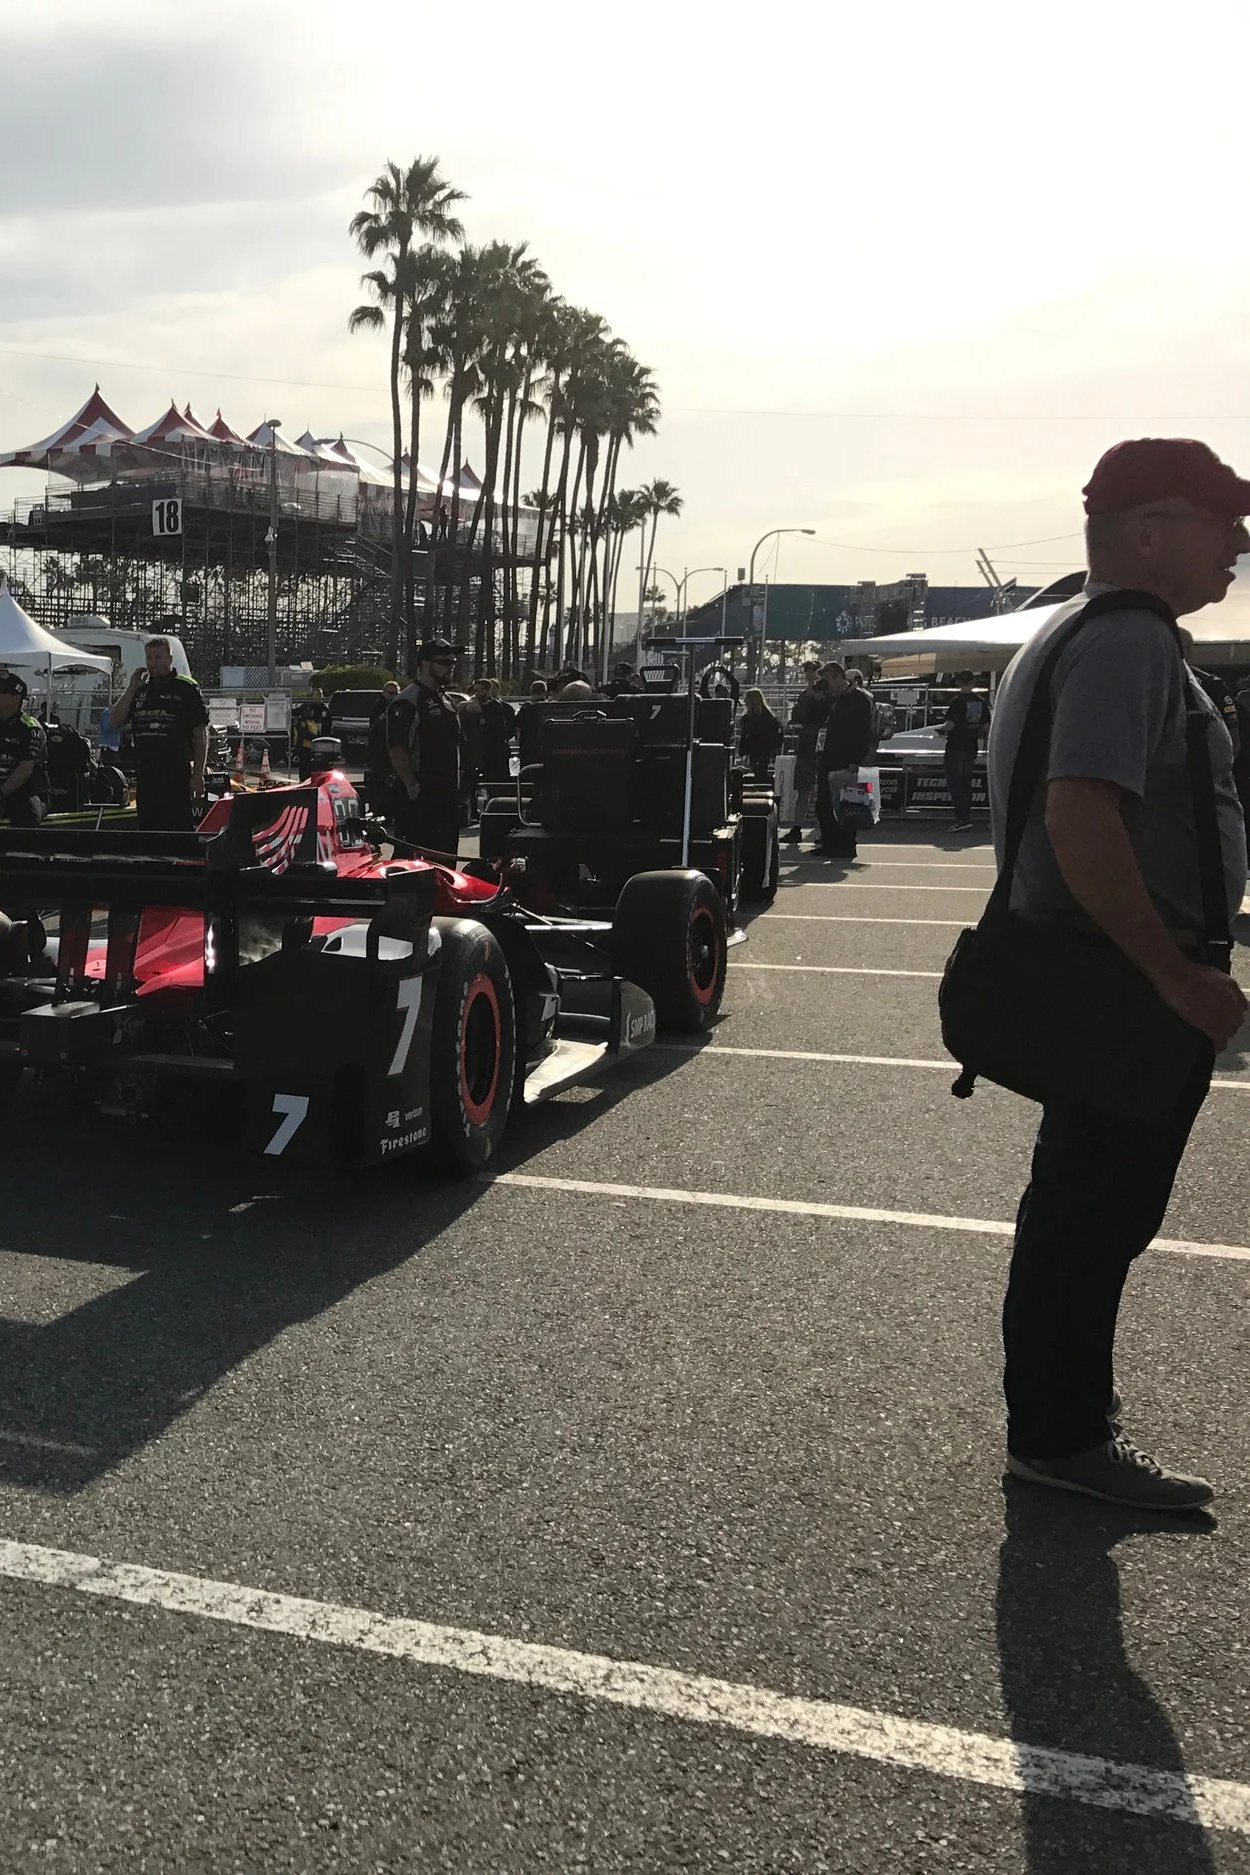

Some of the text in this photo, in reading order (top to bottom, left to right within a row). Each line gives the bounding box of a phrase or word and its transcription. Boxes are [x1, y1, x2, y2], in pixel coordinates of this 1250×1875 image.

[155, 500, 179, 533] 18
[649, 704, 662, 720] 7
[916, 777, 983, 788] TECHL
[388, 976, 423, 1077] 7
[262, 1093, 311, 1156] 7
[404, 1106, 424, 1122] verizon
[379, 1126, 428, 1156] Firestone
